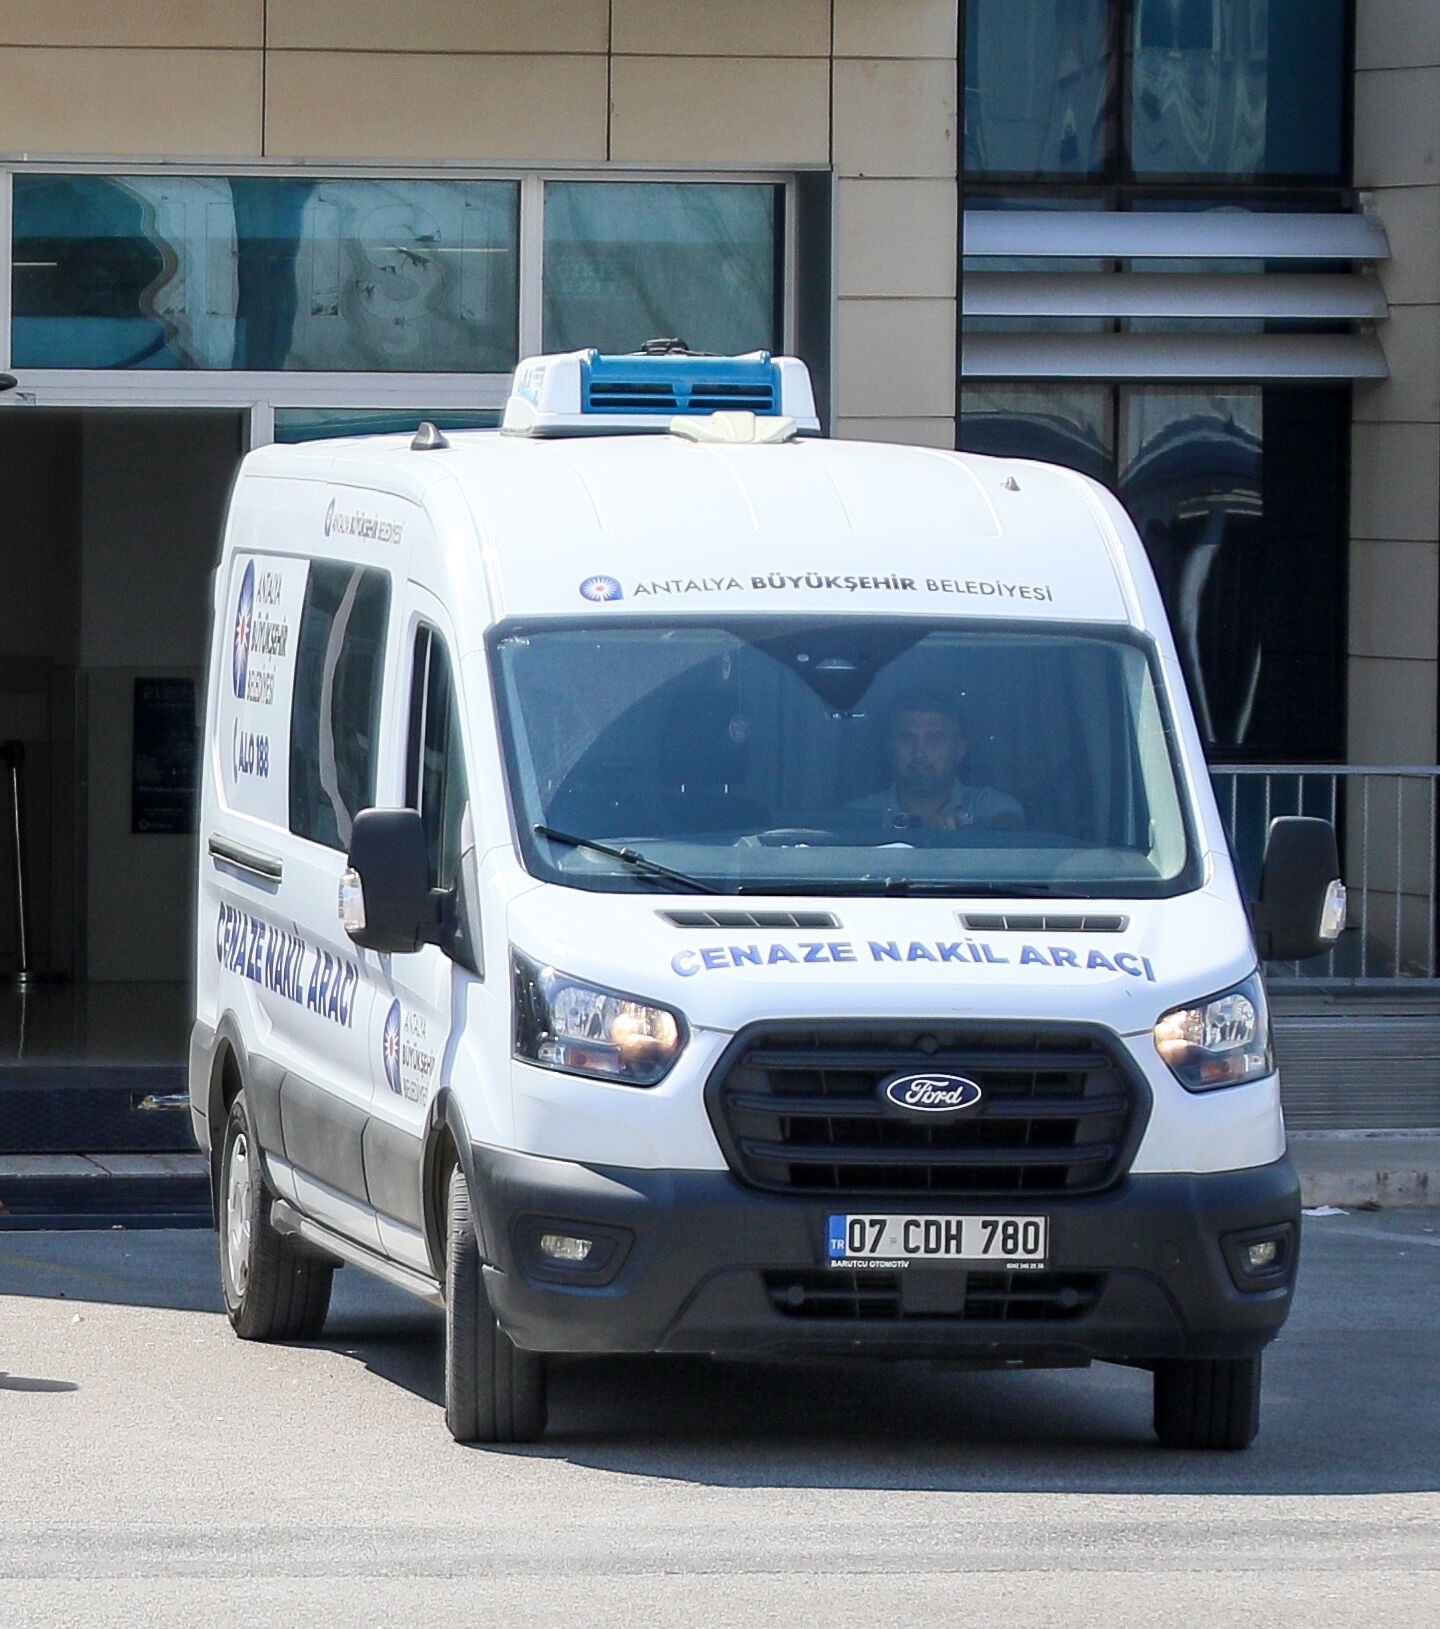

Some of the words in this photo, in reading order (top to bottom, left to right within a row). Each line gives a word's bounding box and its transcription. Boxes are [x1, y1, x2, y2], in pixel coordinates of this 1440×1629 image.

[256, 571, 282, 606] ANTALYA
[633, 577, 743, 597] ANTALYA
[751, 572, 917, 594] BÜYÜKŞEHİR
[926, 578, 1054, 602] BELEDİYESİ
[238, 731, 254, 775] ALO
[256, 734, 269, 778] 188
[217, 901, 266, 984] CENAZE
[266, 926, 306, 1004] NAKİL
[670, 942, 859, 978] CENAZE
[867, 938, 1010, 965] NAKİL
[1019, 945, 1158, 982] ARACI
[905, 1079, 964, 1104] Ford
[831, 1238, 845, 1250] TR
[848, 1218, 887, 1253] 07
[903, 1219, 963, 1254] CDH
[981, 1220, 1040, 1255] 780
